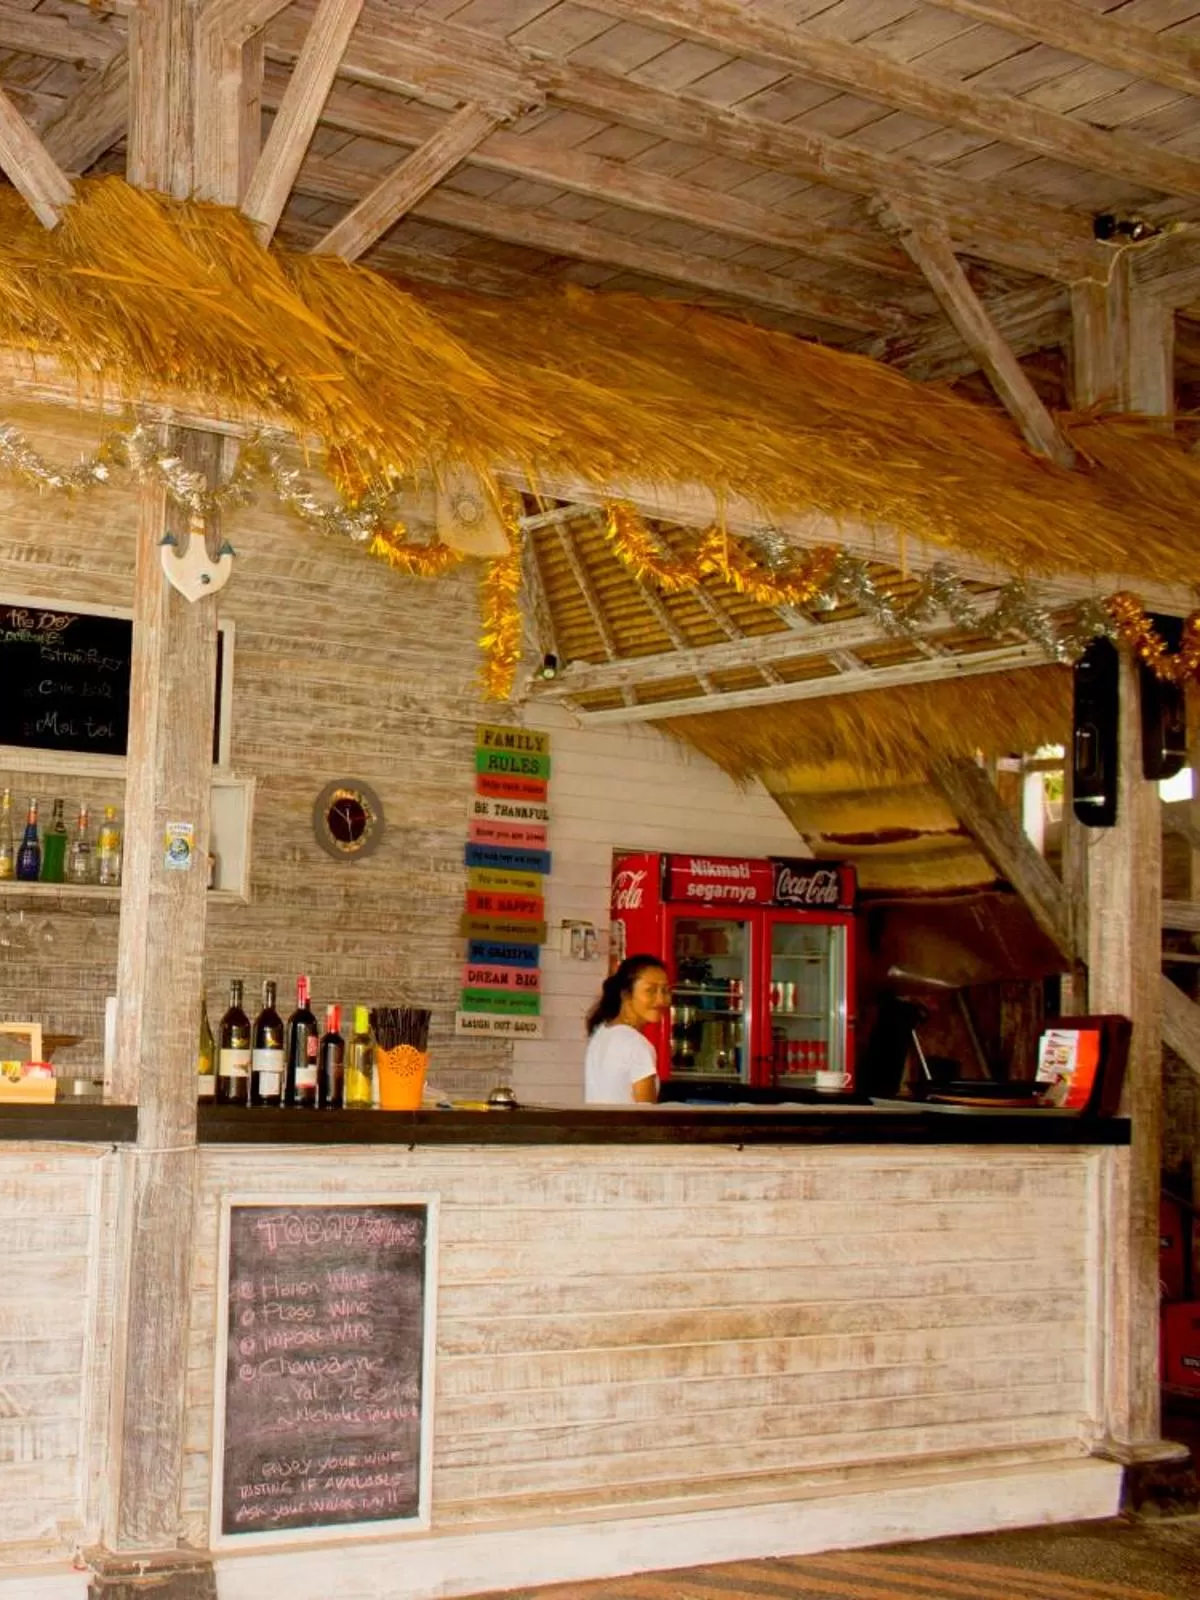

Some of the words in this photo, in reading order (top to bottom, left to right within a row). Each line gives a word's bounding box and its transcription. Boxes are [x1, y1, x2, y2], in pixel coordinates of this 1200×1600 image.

[7, 609, 35, 629] the
[36, 612, 79, 631] Day
[483, 730, 544, 751] FAMILY
[488, 754, 540, 774] RULES
[474, 801, 490, 814] BE
[493, 804, 549, 821] THANKFUL
[689, 859, 751, 879] Nikmati
[686, 881, 757, 903] segarnya
[475, 895, 493, 910] BE
[467, 970, 508, 986] DREAM
[515, 974, 538, 987] BIG
[461, 1018, 490, 1030] LAUGH
[493, 1020, 511, 1032] OUT
[513, 1022, 537, 1033] LOUD
[300, 1477, 317, 1493] IF
